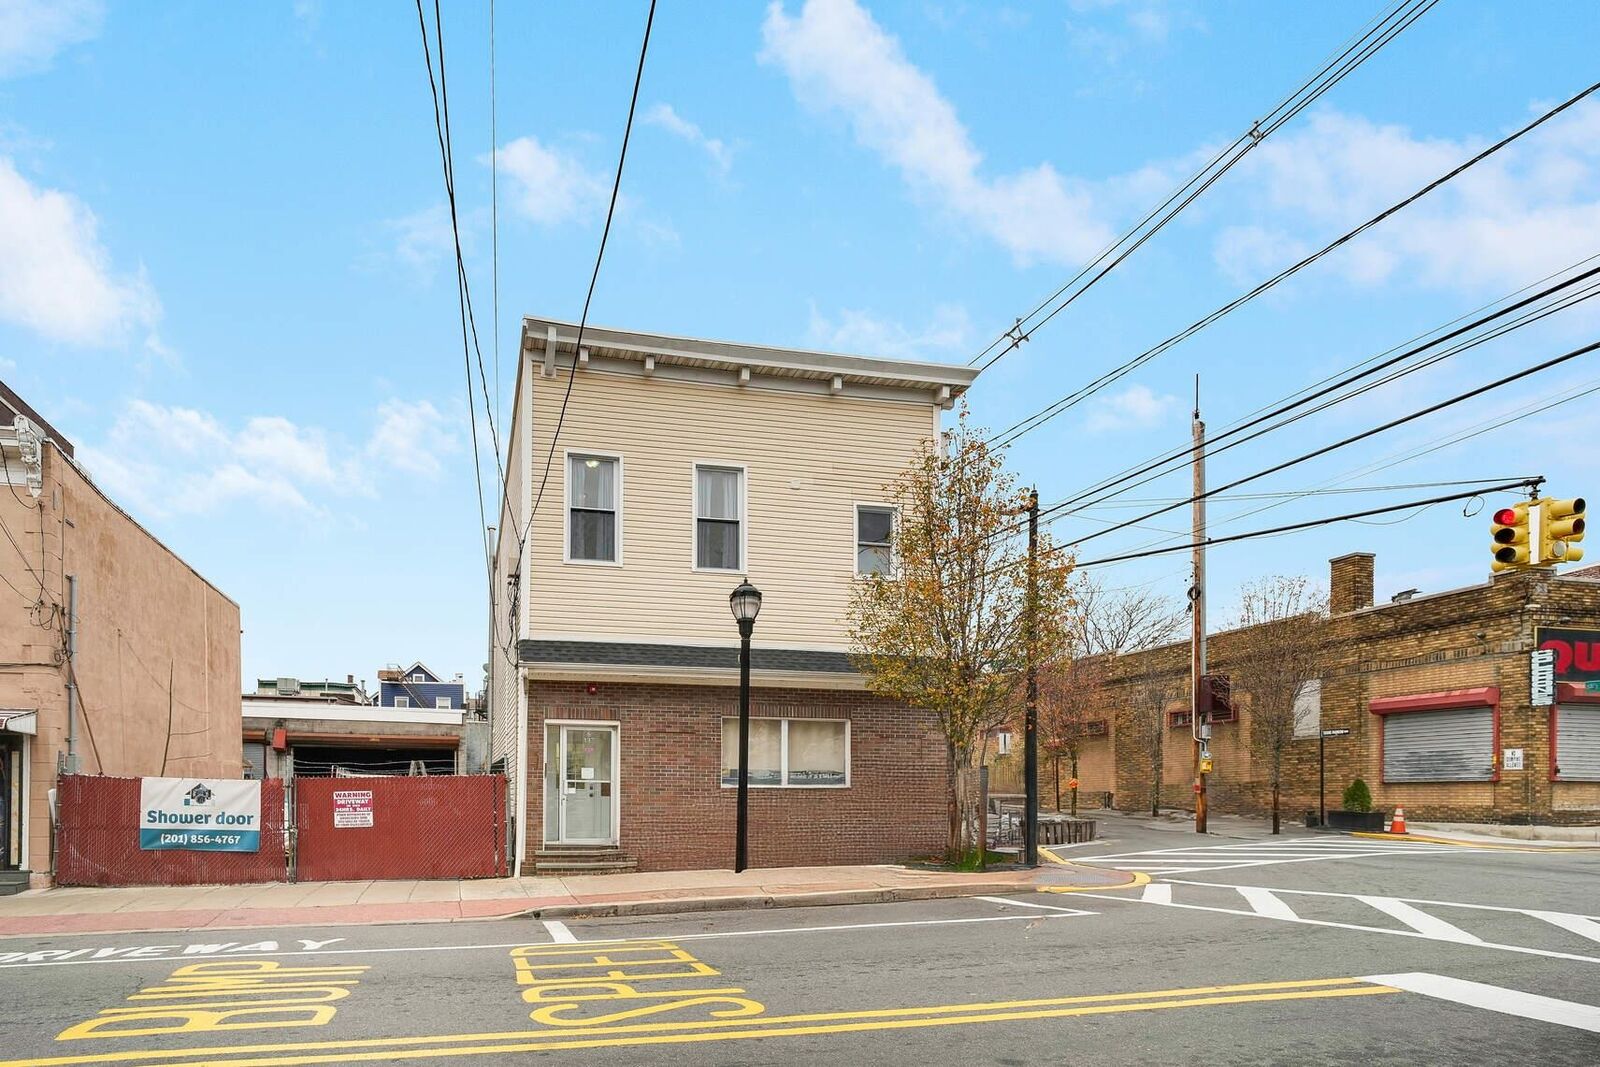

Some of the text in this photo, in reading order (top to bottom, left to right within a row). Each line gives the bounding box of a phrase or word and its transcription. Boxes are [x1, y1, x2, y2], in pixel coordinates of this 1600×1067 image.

[147, 810, 254, 825] Shower door
[160, 834, 241, 845] (201) 856-4767
[57, 960, 371, 1041] BUMP
[510, 940, 765, 1027] SPEED
